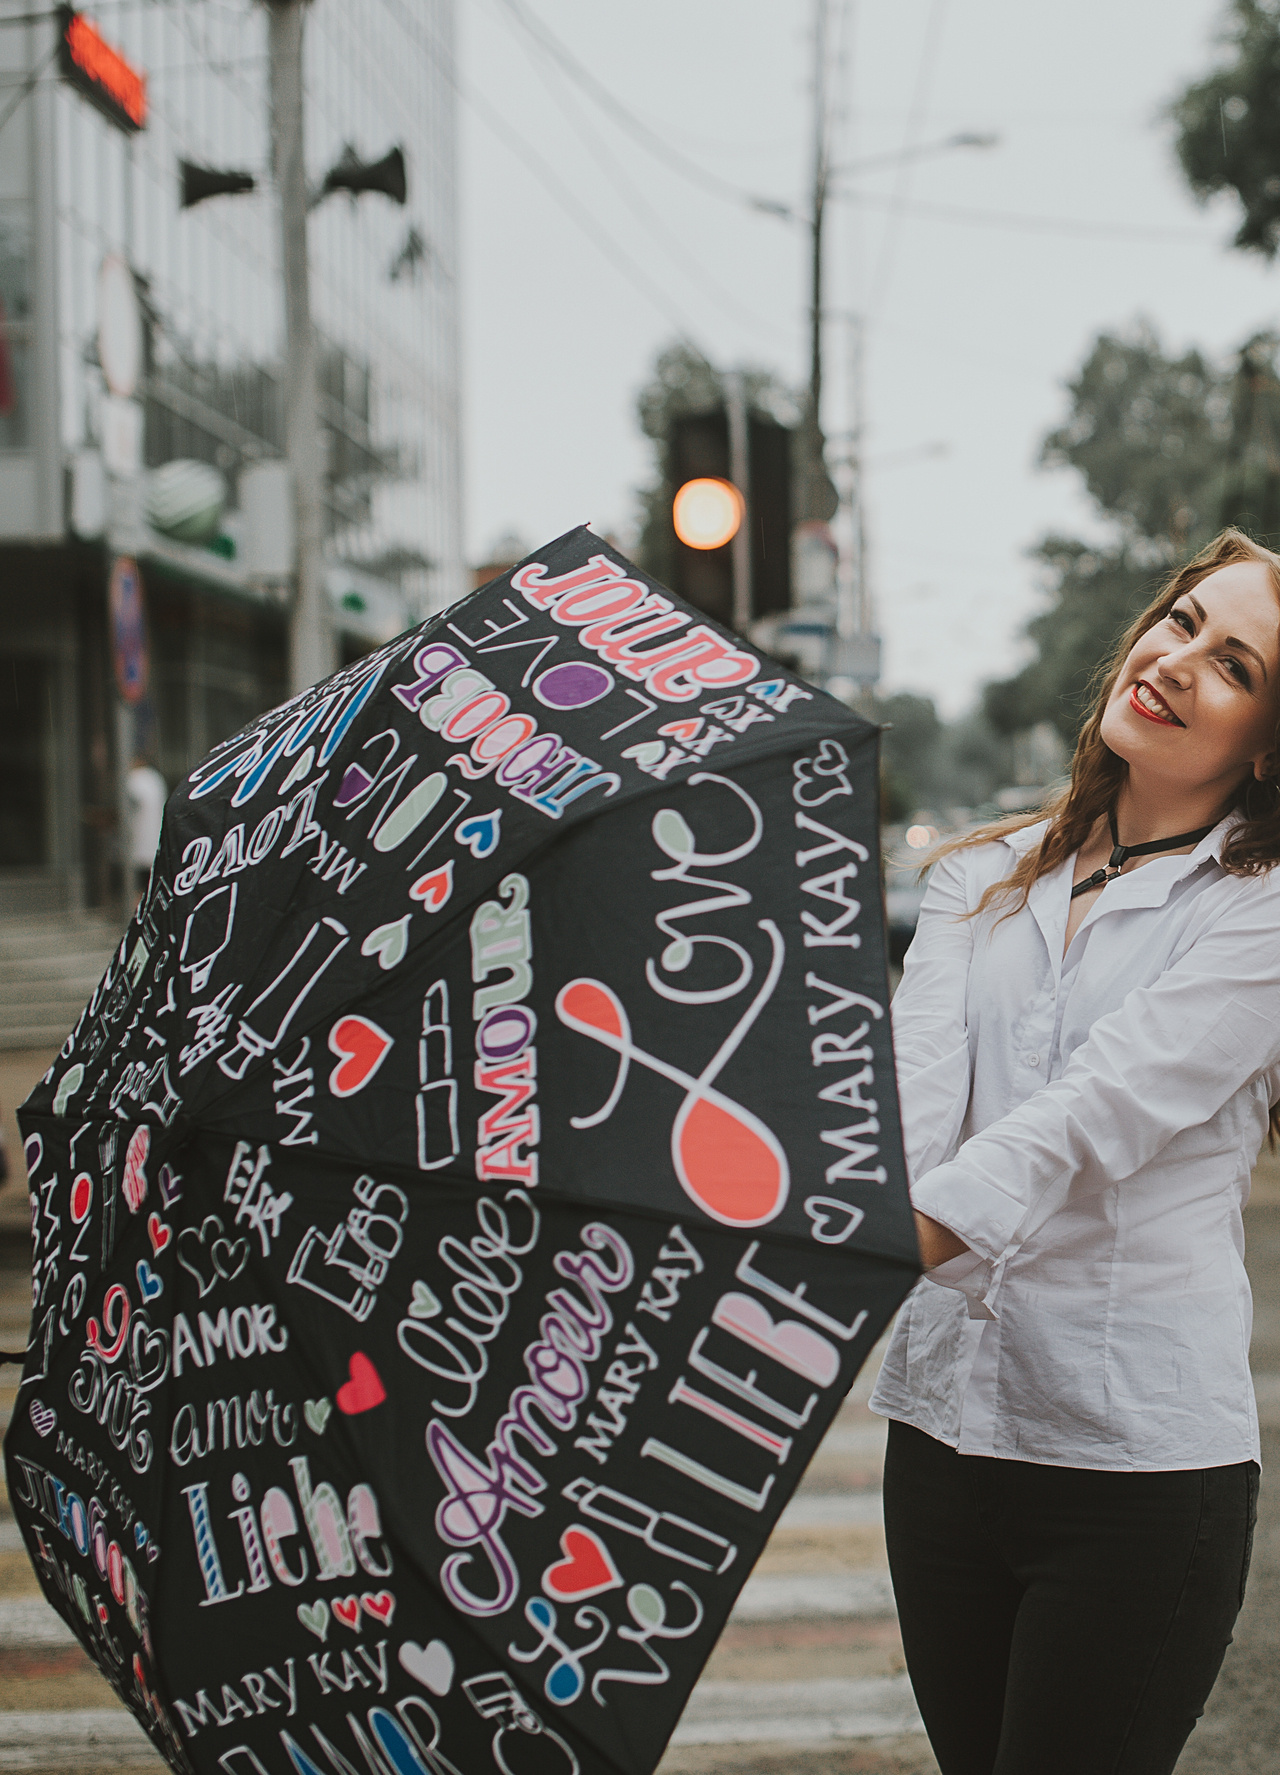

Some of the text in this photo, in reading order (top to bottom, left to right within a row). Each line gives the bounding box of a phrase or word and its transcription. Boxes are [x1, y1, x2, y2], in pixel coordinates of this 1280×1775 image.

[447, 598, 658, 741] LOVE
[272, 1036, 318, 1146] MK
[470, 872, 540, 1188] AMOUR
[795, 811, 888, 1185] MARY KAY
[173, 1303, 289, 1378] AMOR
[574, 1225, 704, 1463] MARY KAY
[640, 1241, 868, 1512] LIEBE
[173, 1657, 296, 1738] MARY
[306, 1641, 388, 1695] KAY
